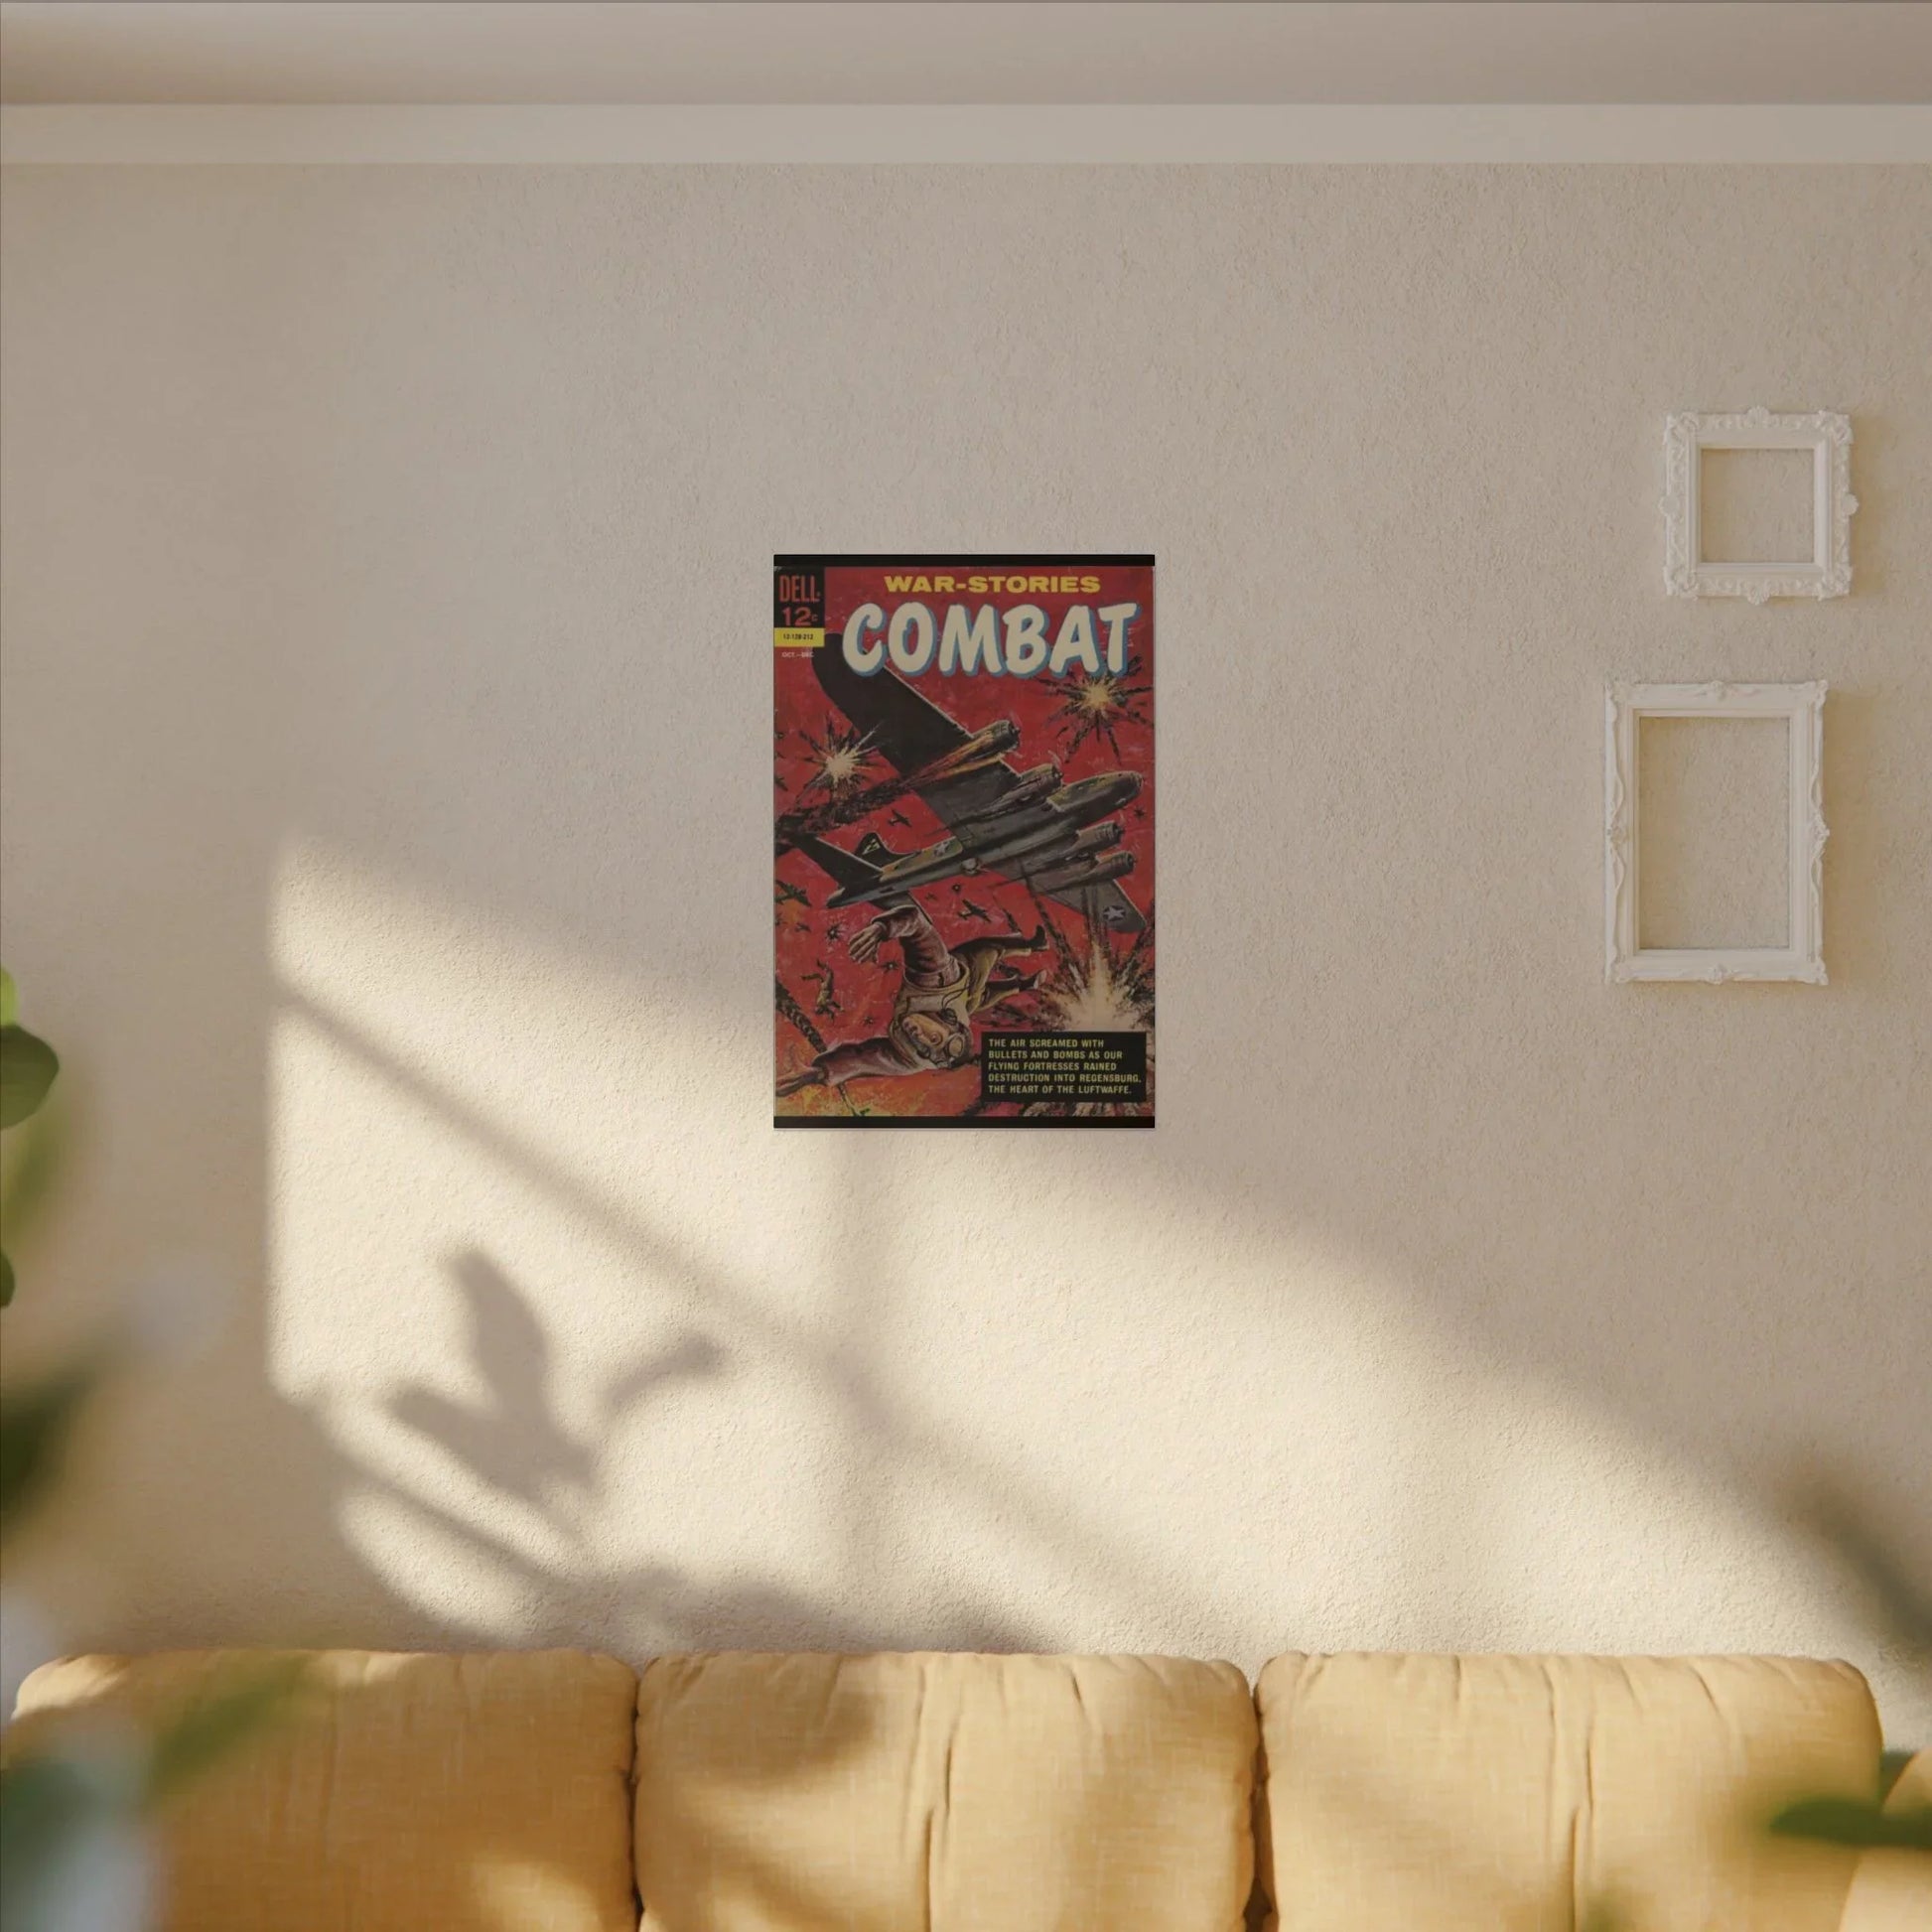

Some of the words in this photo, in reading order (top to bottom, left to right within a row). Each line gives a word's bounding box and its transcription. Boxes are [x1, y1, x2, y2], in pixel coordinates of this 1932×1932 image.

[779, 575, 820, 603] DELL
[885, 575, 1101, 594] WAR-STORIES
[842, 602, 1141, 677] COMBAT
[989, 1038, 1006, 1047] THE
[1010, 1038, 1026, 1047] AIR
[1030, 1038, 1078, 1047] SCREAMED
[1081, 1038, 1104, 1047] WITH
[988, 1050, 1028, 1059] BULLETS
[1031, 1050, 1049, 1059] AND
[1053, 1050, 1085, 1059] BOMBS
[1088, 1050, 1100, 1059] AS
[1104, 1050, 1123, 1059] OUR
[988, 1073, 1049, 1082] DESTRUCTION
[1054, 1073, 1075, 1082] INTO
[989, 1085, 1005, 1094] THE
[1010, 1085, 1038, 1094] HEART
[1042, 1085, 1053, 1094] OF
[1057, 1085, 1074, 1094] THE
